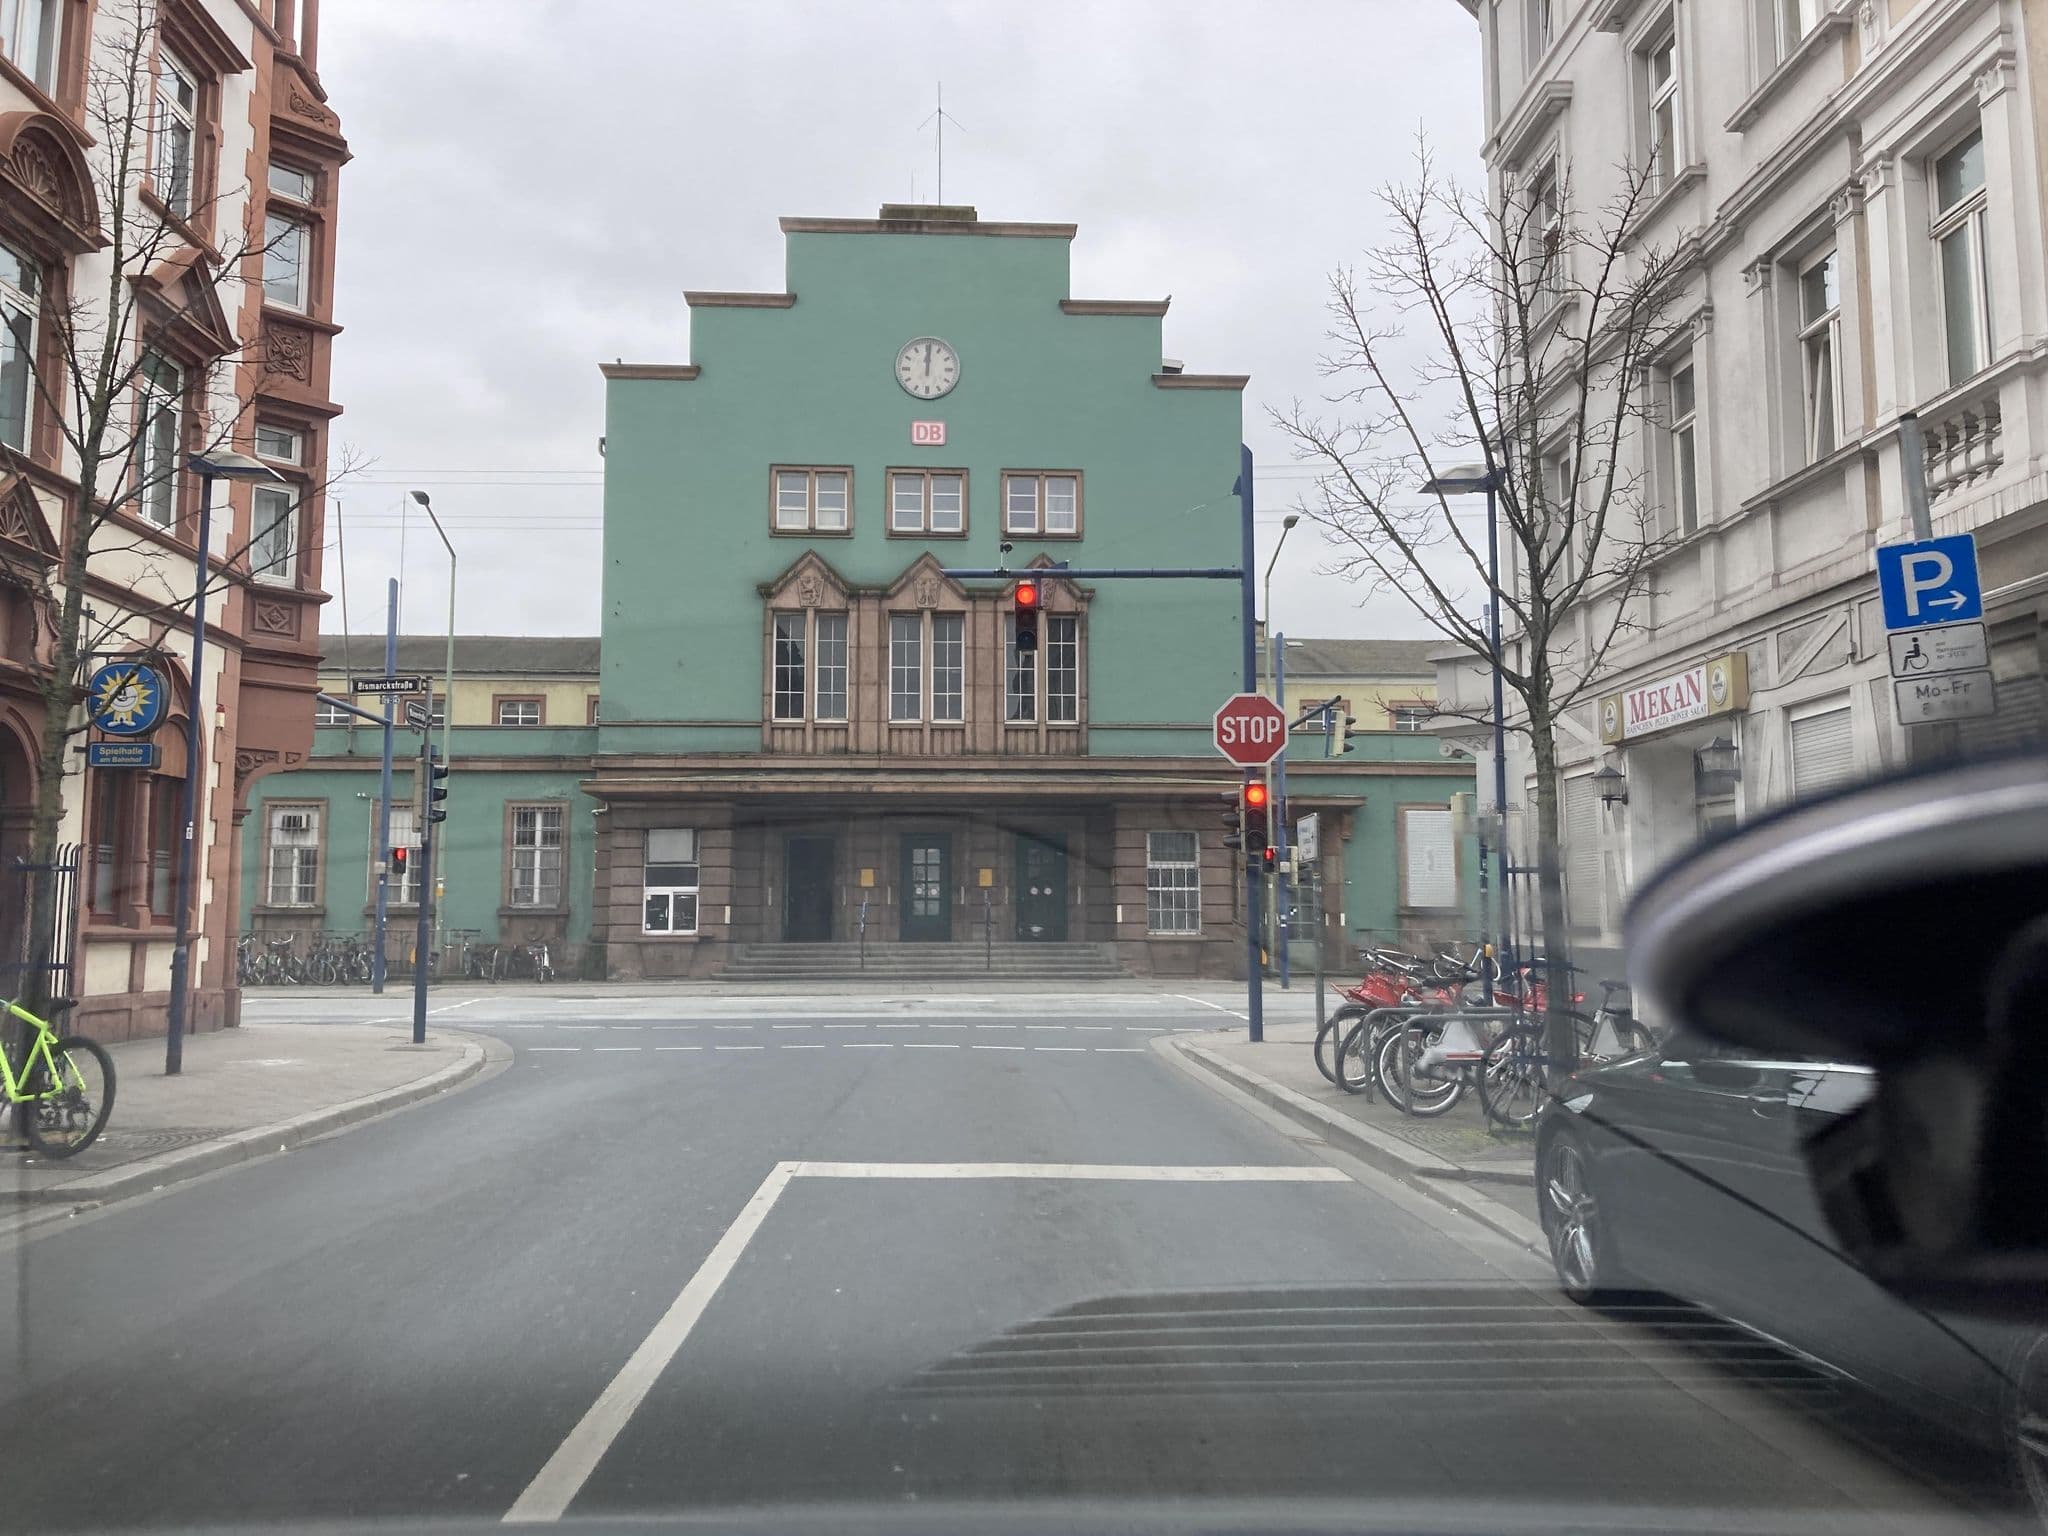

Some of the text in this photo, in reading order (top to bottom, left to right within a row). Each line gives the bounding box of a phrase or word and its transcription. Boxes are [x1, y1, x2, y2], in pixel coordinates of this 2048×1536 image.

[915, 424, 942, 440] DB
[1900, 550, 1954, 617] P
[357, 681, 413, 690] Bismarckstraße
[1916, 681, 1971, 699] Mo-Fr
[1628, 670, 1702, 725] MEKAN
[1221, 716, 1281, 744] STOP
[99, 747, 143, 756] Spielhalle
